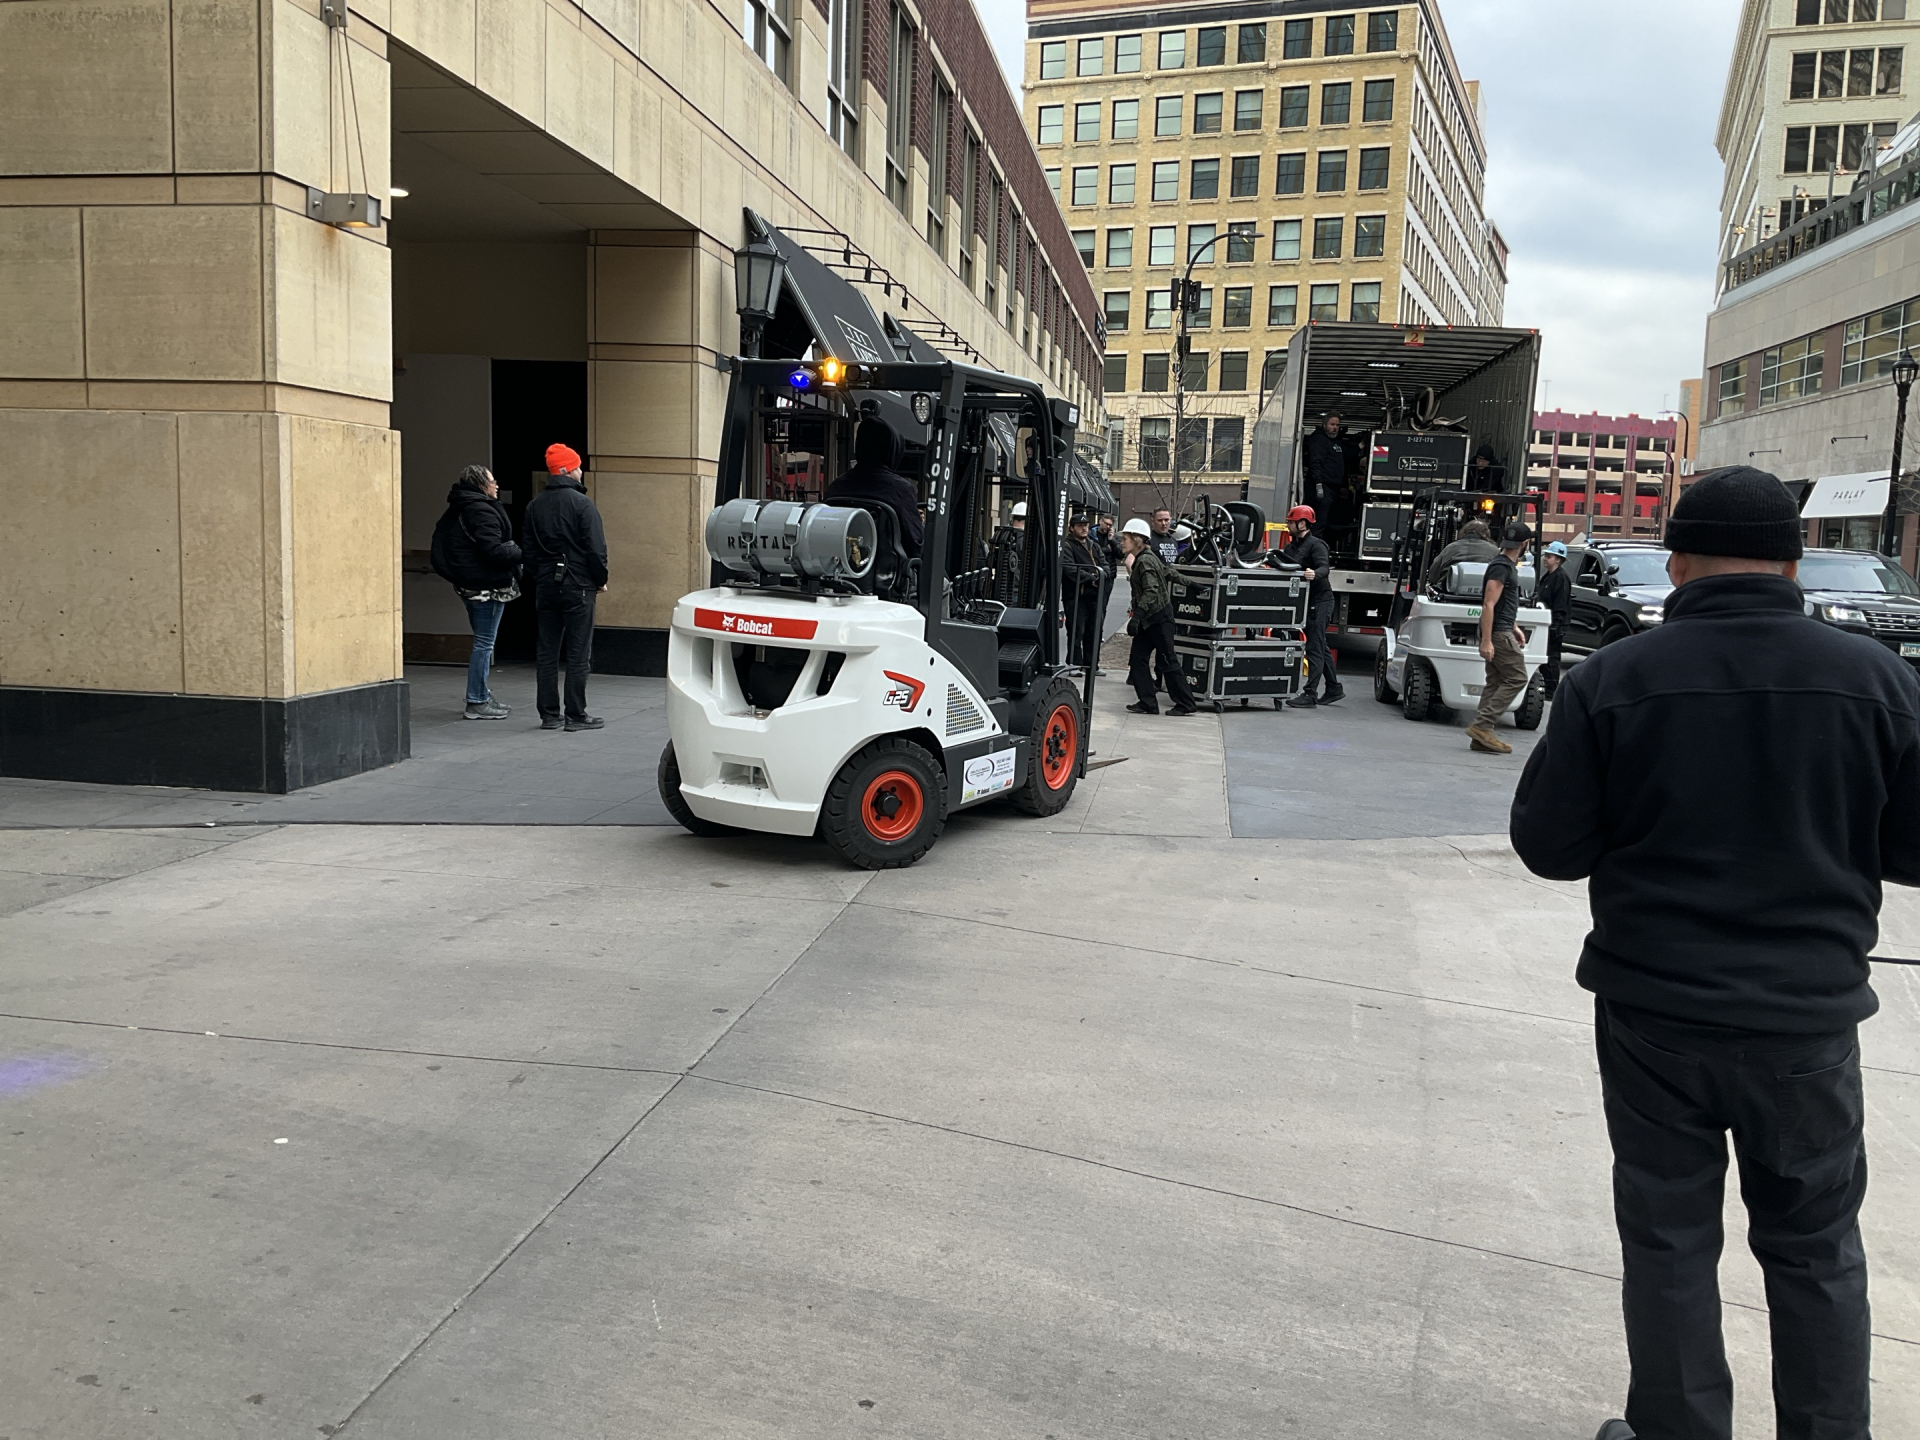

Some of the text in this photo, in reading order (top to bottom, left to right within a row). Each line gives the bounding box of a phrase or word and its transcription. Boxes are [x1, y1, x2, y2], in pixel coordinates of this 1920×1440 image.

[1410, 332, 1419, 343] 2
[926, 428, 943, 512] 11015
[940, 432, 954, 516] 11015
[1833, 489, 1866, 499] PARLAY
[1057, 490, 1067, 536] Bobcat
[1427, 502, 1437, 541] 11517
[727, 535, 791, 550] RENTAL
[736, 618, 773, 635] Bobcat
[883, 689, 910, 706] G25
